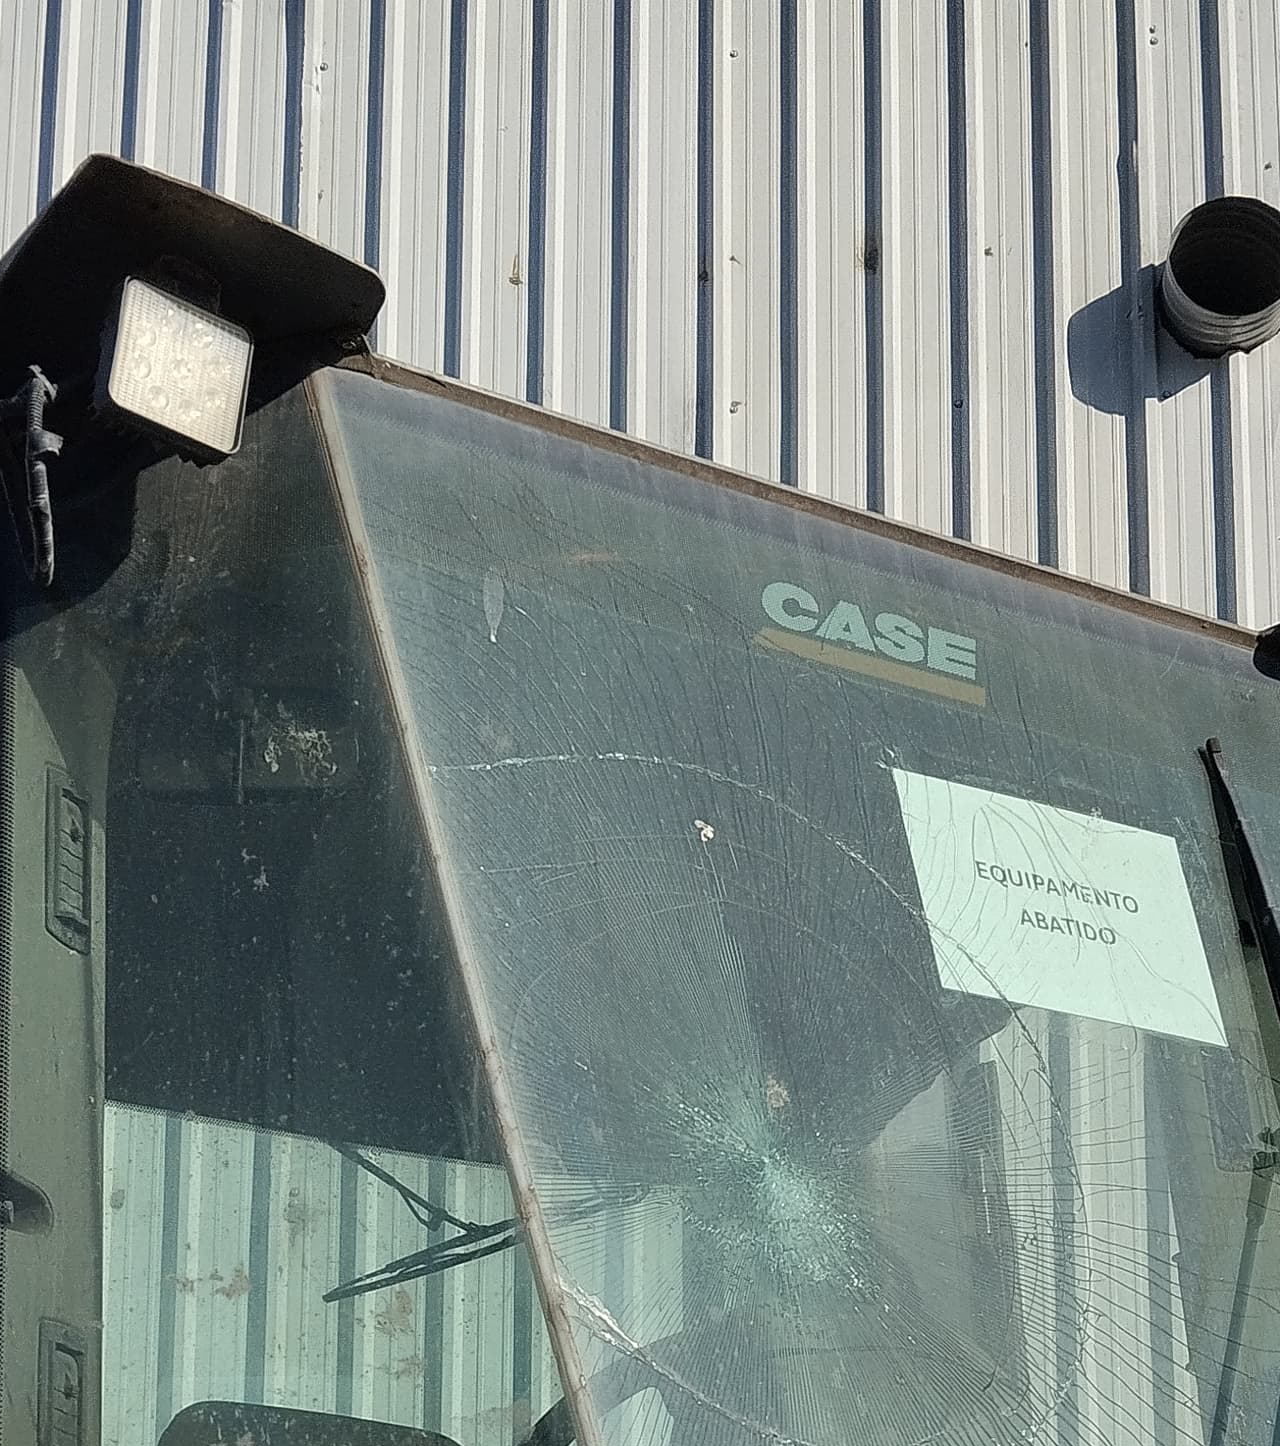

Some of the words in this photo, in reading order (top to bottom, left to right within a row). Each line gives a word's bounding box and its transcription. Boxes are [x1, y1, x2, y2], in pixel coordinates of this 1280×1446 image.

[761, 582, 977, 681] CASE
[974, 860, 1139, 915] EQUIPAMENTO
[1019, 908, 1118, 946] ABATIDO
